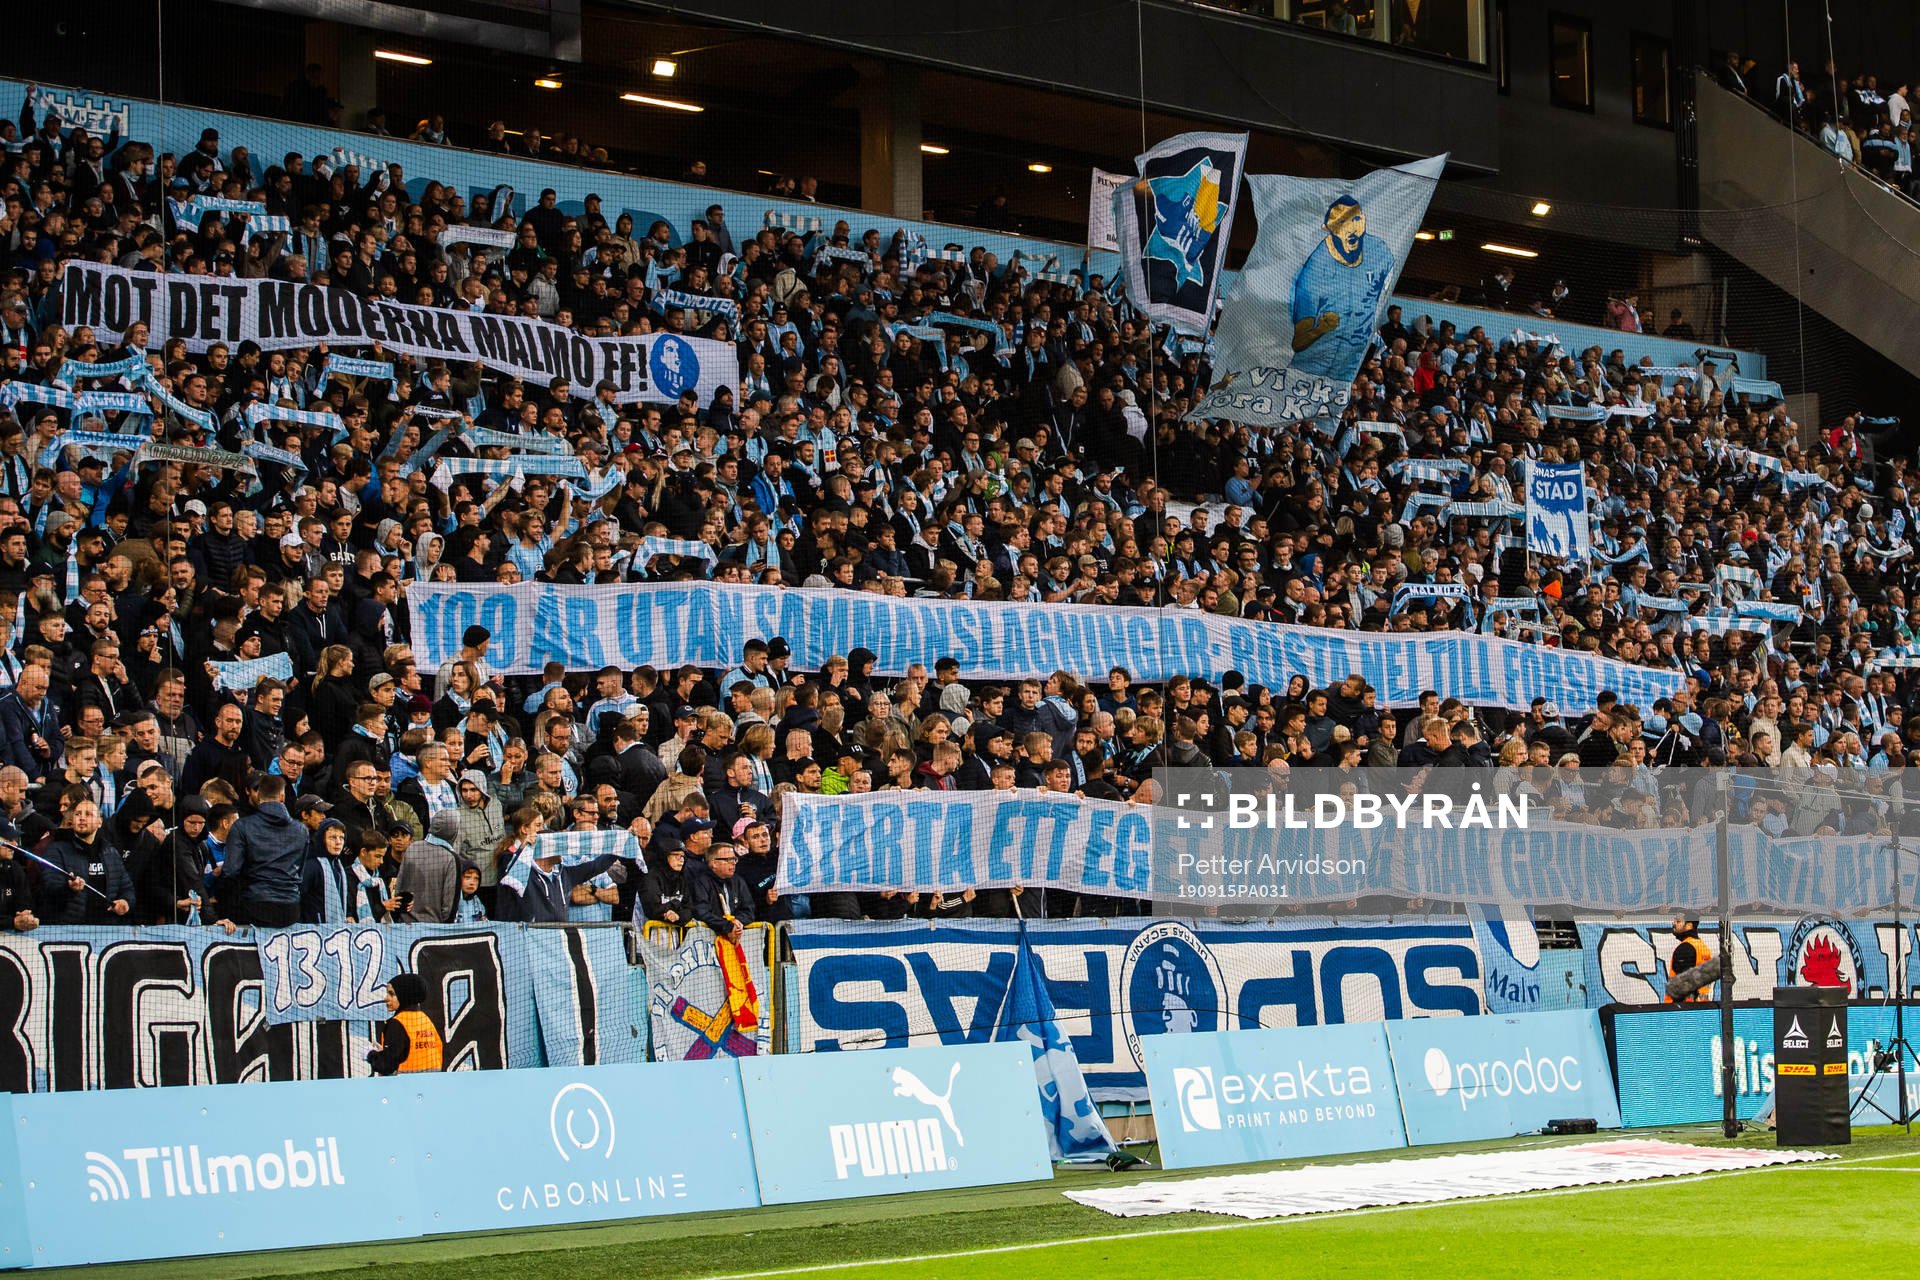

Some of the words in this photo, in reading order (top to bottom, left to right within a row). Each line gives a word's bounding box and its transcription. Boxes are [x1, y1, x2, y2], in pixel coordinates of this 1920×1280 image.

[65, 265, 157, 334] MOT
[168, 281, 247, 342] DET
[258, 281, 471, 353] MODERNA
[598, 341, 648, 392] FF!
[1250, 367, 1287, 391] Vi
[1292, 378, 1350, 406] ska
[1536, 480, 1577, 500] STAD
[418, 591, 518, 669] 109
[529, 585, 605, 669] ÅR
[616, 586, 744, 666] UTAN
[1425, 638, 1497, 701] TILL
[787, 801, 976, 888] STARTA
[988, 800, 1081, 881] ETT
[1129, 928, 1168, 963] SCANIA
[1173, 927, 1209, 961] ULTRAS
[264, 929, 388, 1013] 1312
[1783, 1040, 1809, 1048] SELECT
[1826, 1039, 1843, 1048] SELECT
[1222, 1060, 1372, 1104] exakta
[1455, 1047, 1582, 1111] prodoc
[1826, 1065, 1843, 1073] DHL
[1227, 1112, 1271, 1129] PRINT
[1279, 1109, 1309, 1125] AND
[1315, 1103, 1376, 1122] BEYOND
[123, 1136, 345, 1198] Tillmobil
[829, 1118, 947, 1180] PUMA
[497, 1173, 688, 1212] CABONLINE
